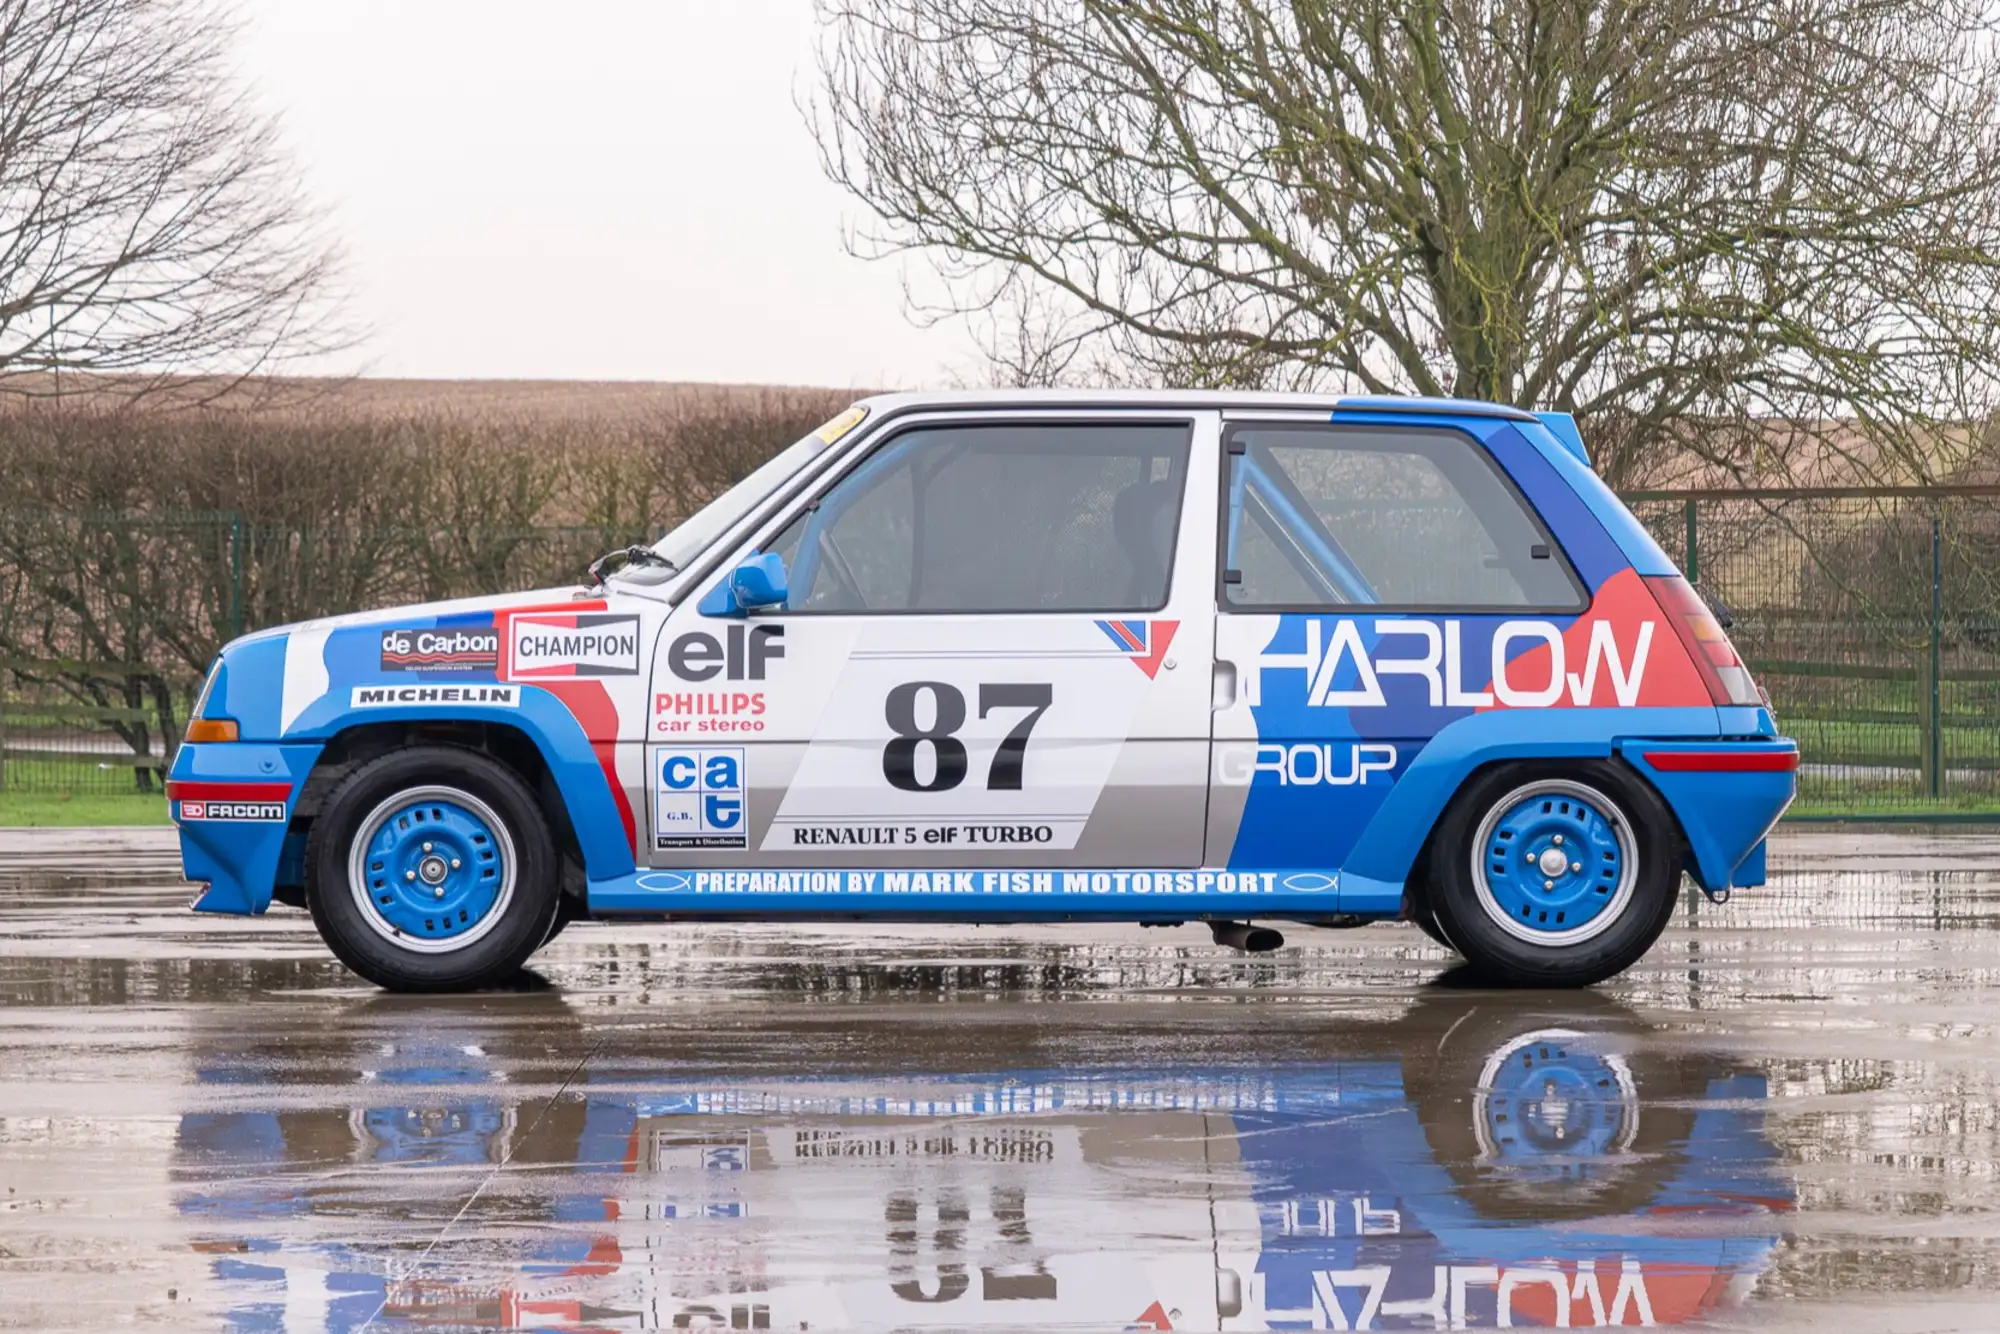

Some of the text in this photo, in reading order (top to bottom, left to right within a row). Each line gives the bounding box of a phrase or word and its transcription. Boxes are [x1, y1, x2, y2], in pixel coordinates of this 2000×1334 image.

[382, 632, 497, 654] de Carbon
[519, 634, 634, 657] CHAMPION
[668, 624, 785, 682] elf
[1247, 619, 1655, 707] HARLOW
[360, 688, 512, 705] MICHELIN
[655, 693, 766, 715] PHILIPS
[657, 717, 765, 732] car stereo
[882, 681, 1053, 792] 87
[1219, 744, 1397, 785] GROUP
[208, 804, 282, 818] FACOM
[667, 812, 693, 821] G.B.
[793, 826, 1053, 844] RENAULT 5 elf TURBO
[695, 872, 1276, 892] PREPARATION BY MARK FISH MOTORSPORT
